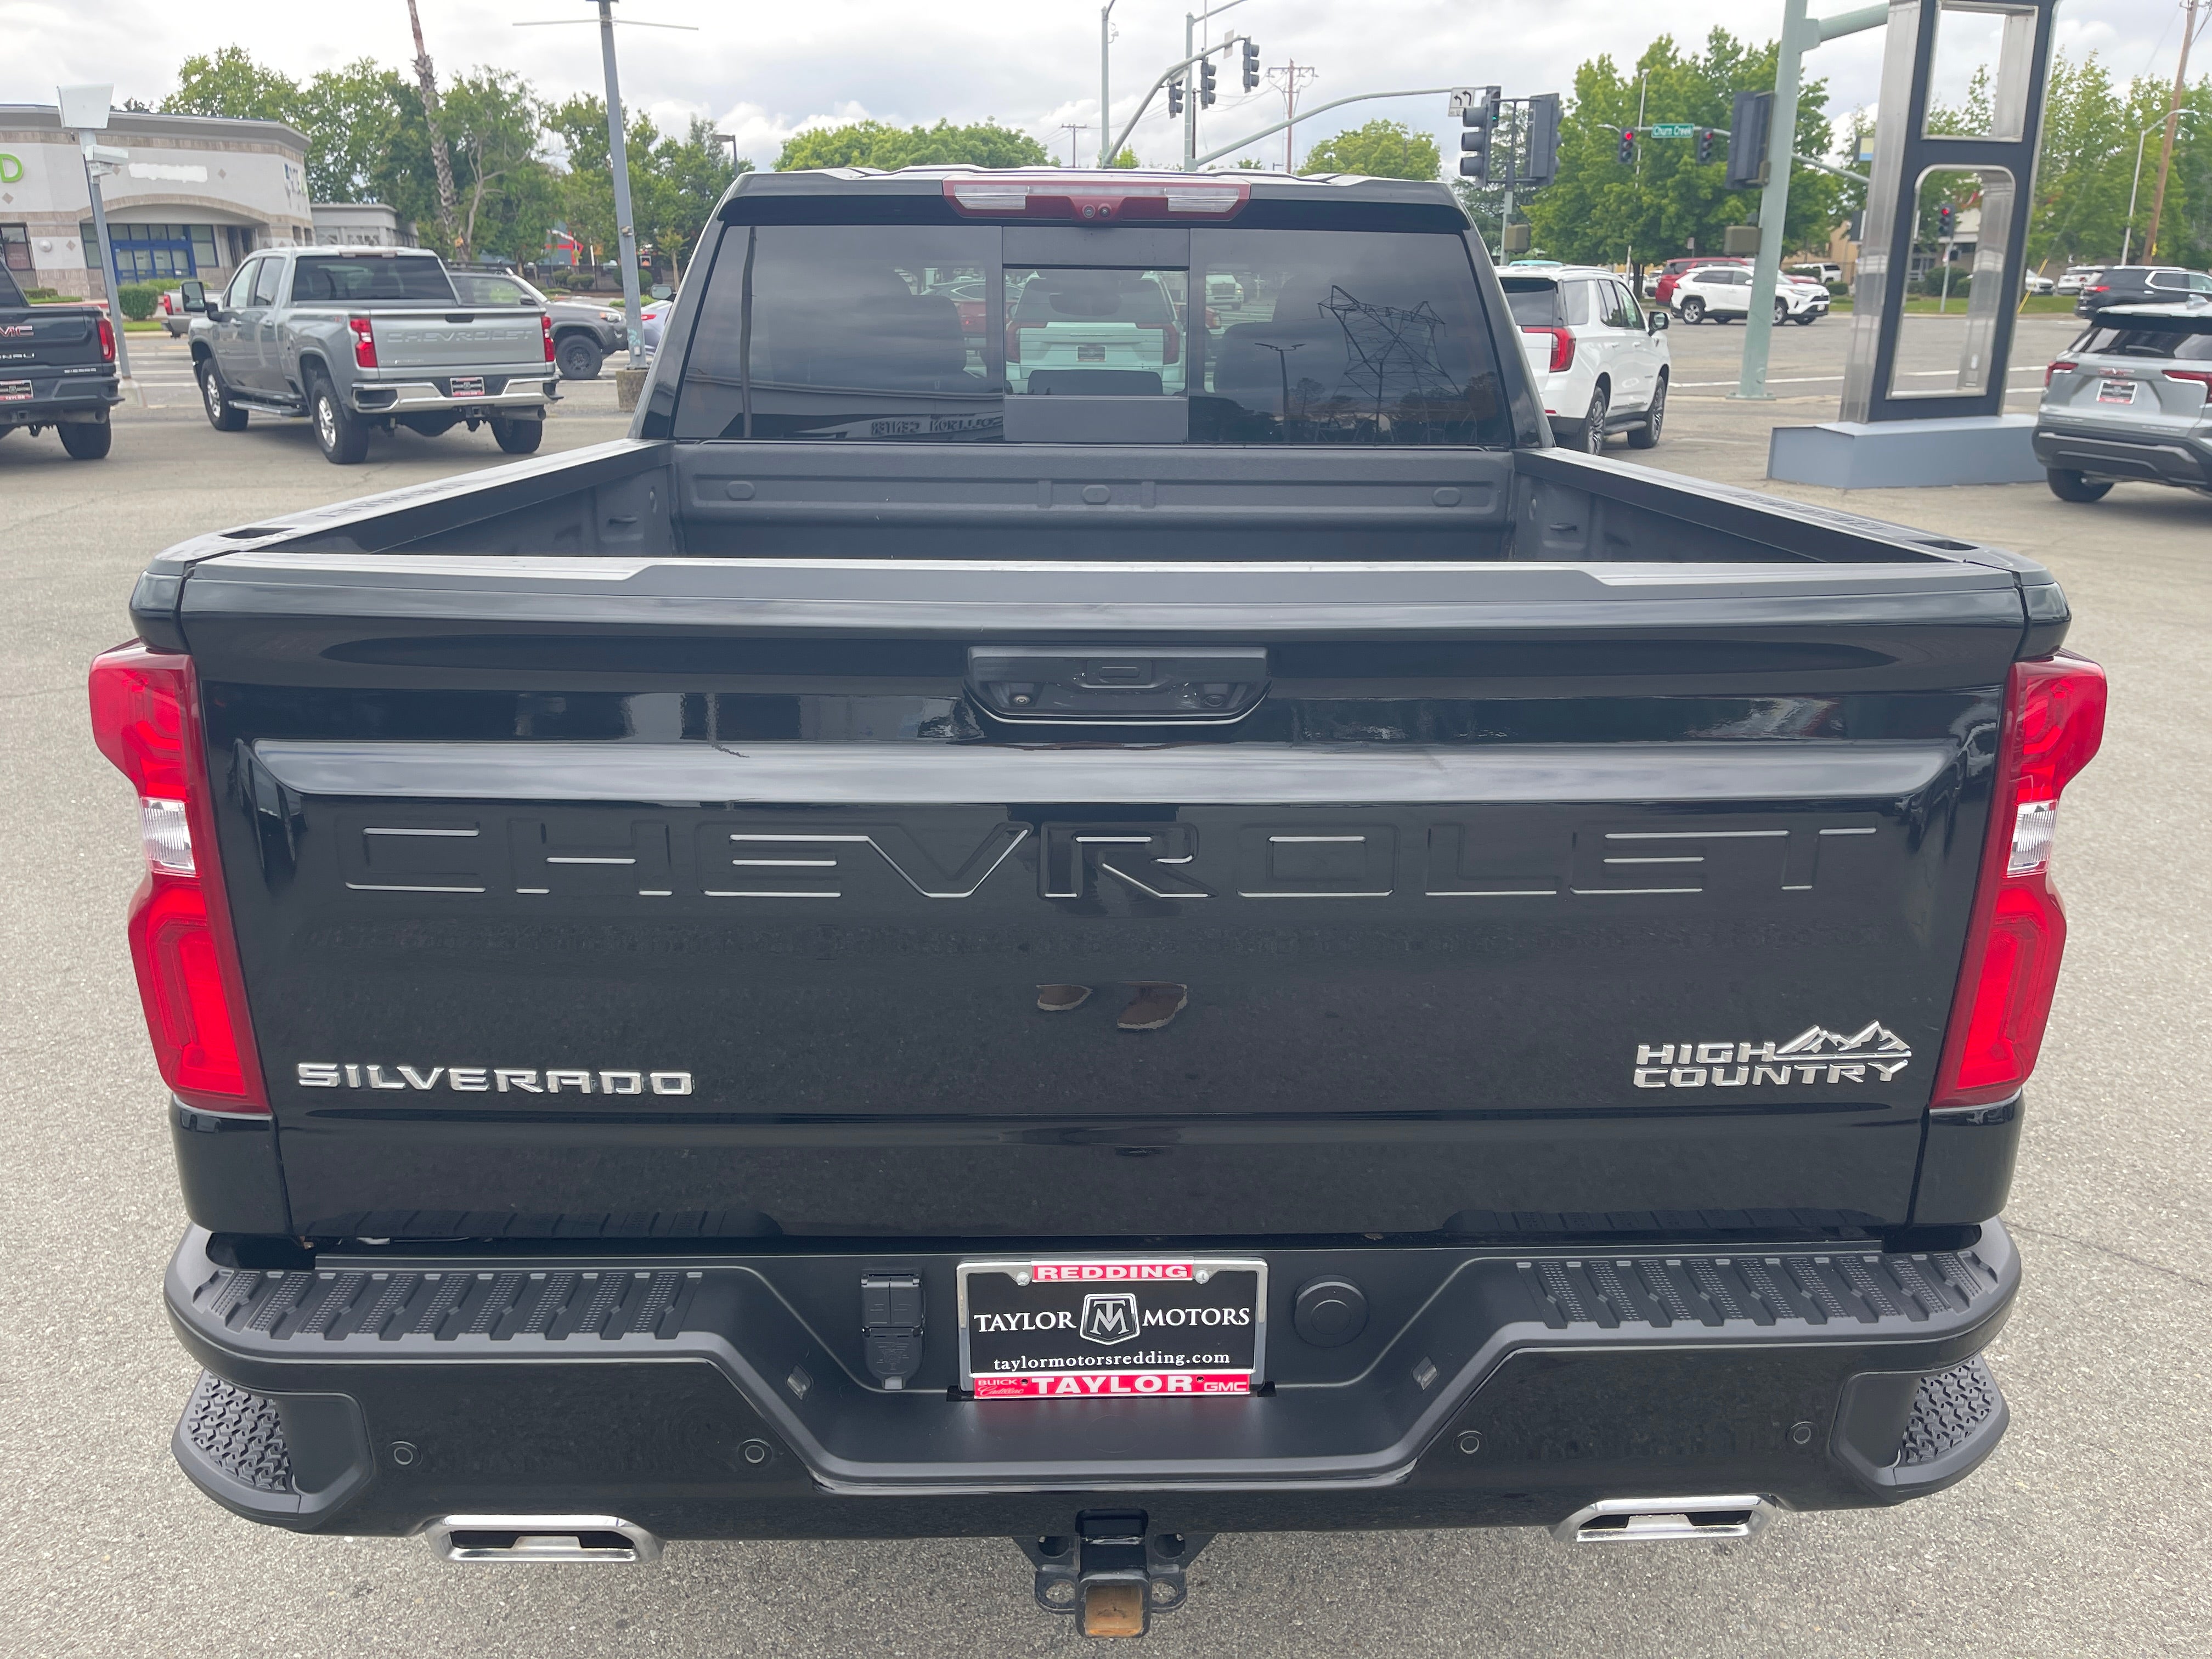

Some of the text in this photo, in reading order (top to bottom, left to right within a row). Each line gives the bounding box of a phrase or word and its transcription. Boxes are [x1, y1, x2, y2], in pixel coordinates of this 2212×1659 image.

[0, 325, 34, 338] MC
[336, 814, 1877, 900] CHEVROLET
[1635, 1040, 1777, 1066] HIGH
[296, 1062, 695, 1097] SILVERADO
[1633, 1059, 1910, 1090] COUNTRY
[1037, 1266, 1188, 1279] REDDING
[973, 1307, 1250, 1333] TAYLOR MOTORS
[994, 1350, 1231, 1372] taylormotorsredding.com
[977, 1385, 1025, 1397] Cadillac
[1031, 1375, 1193, 1395] TAYLOR
[1203, 1381, 1248, 1392] GMC
